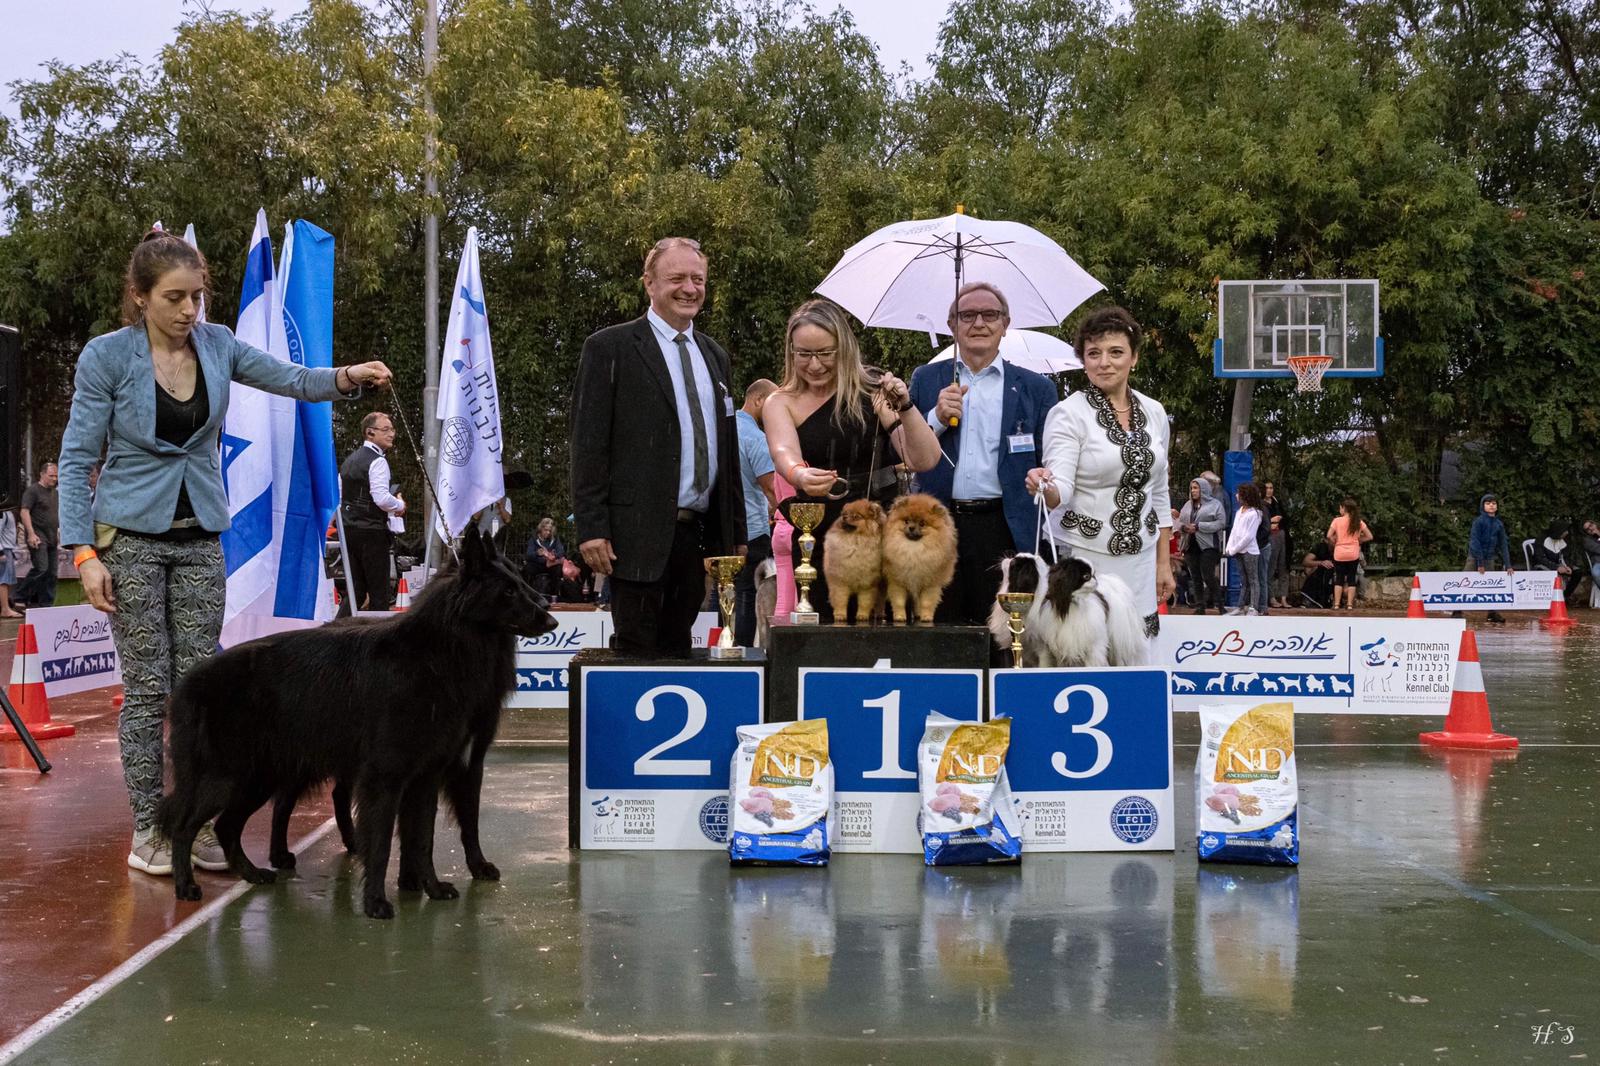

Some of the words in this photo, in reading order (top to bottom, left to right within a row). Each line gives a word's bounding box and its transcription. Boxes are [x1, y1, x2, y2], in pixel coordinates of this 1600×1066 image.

[452, 433, 464, 450] FCI
[1472, 577, 1506, 587] אוהבים
[54, 618, 80, 652] כלבים
[80, 620, 109, 640] אוהבים
[1176, 630, 1244, 664] כלבים
[1246, 632, 1334, 656] אוהבים
[1406, 642, 1450, 651] ההתאחדות
[1406, 652, 1450, 661] הישראלית
[1406, 662, 1450, 671] לכלבנות
[1406, 673, 1450, 682] Israel
[1406, 684, 1432, 692] Kennel
[1433, 684, 1450, 692] Club
[634, 684, 711, 776] 2
[862, 690, 917, 779] 1
[1050, 684, 1114, 778] 3
[762, 749, 820, 778] N&D
[950, 750, 1001, 776] N&D
[1227, 747, 1286, 772] N&D
